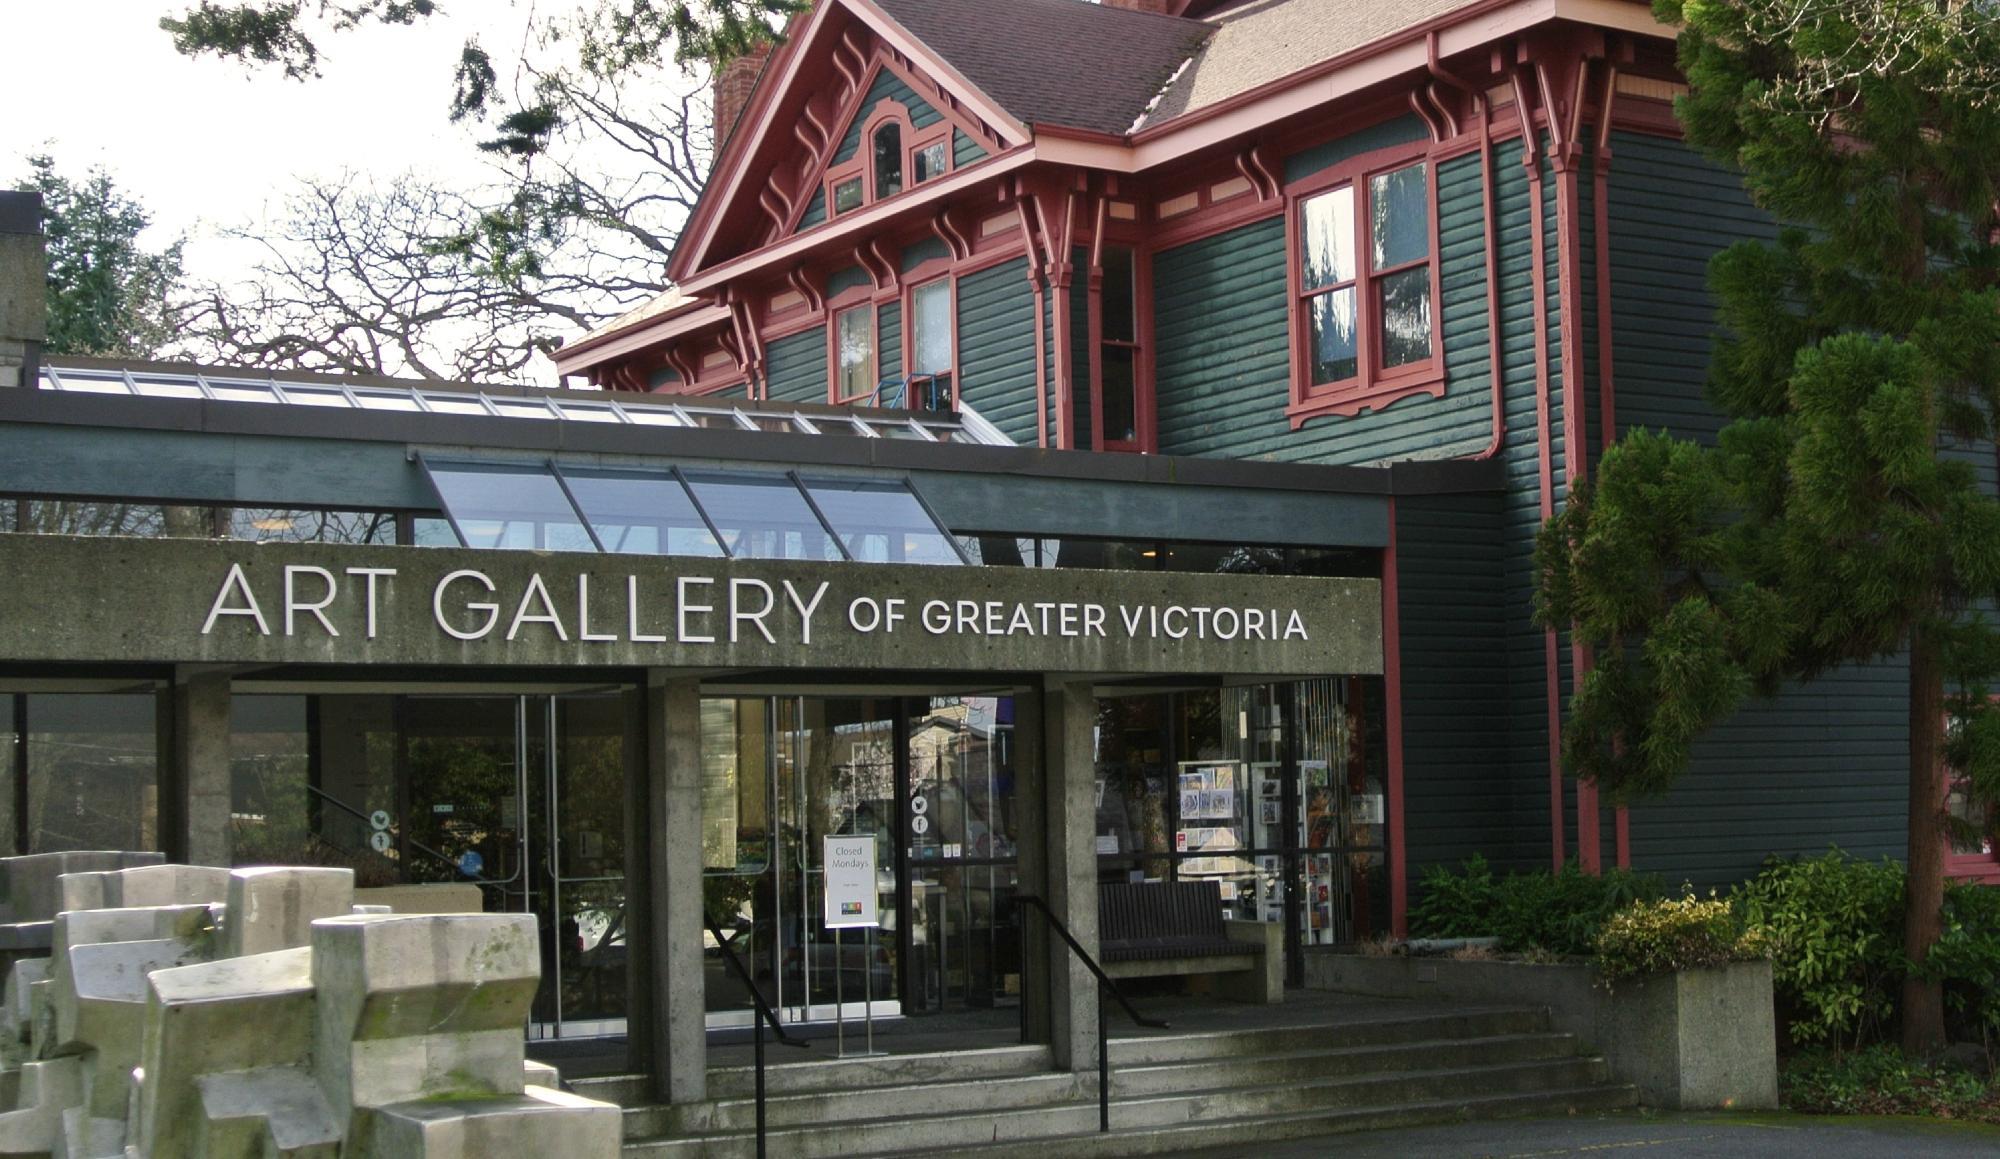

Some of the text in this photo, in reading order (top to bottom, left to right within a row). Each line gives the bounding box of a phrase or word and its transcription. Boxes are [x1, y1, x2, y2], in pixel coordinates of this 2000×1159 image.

[201, 563, 1309, 644] ART GALLERY OF GREATER VICTORIA
[835, 846, 862, 856] Closed
[832, 858, 869, 870] Mondays
